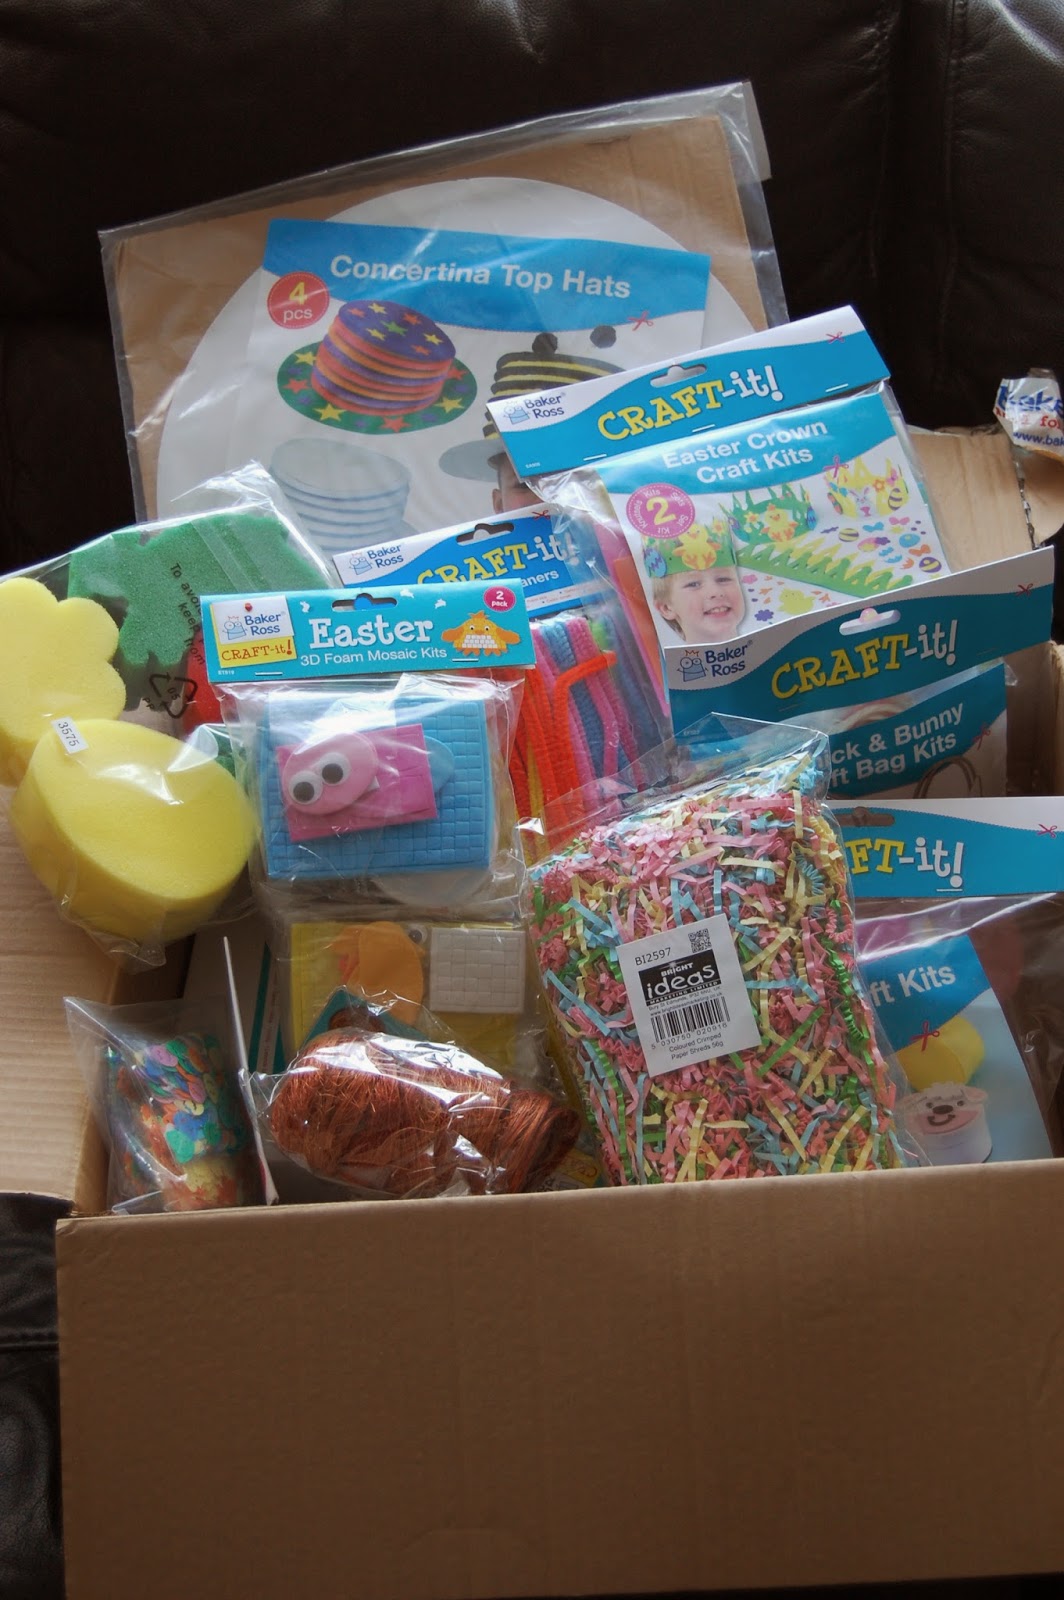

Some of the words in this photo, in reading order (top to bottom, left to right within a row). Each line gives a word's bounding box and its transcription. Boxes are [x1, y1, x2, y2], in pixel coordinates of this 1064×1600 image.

[330, 254, 490, 285] Concertina
[501, 264, 553, 294] Top
[563, 270, 631, 298] Hats
[289, 281, 307, 305] 4
[283, 306, 313, 323] pcs
[524, 395, 562, 409] Baker
[597, 365, 784, 441] CRAFT-it!
[532, 407, 565, 419] Ross
[663, 439, 741, 469] Easter
[748, 420, 828, 449] Crown
[696, 458, 761, 485] Craft
[767, 447, 813, 472] Kits
[646, 496, 677, 526] 2
[367, 544, 402, 560] Baker
[375, 553, 405, 568] Ross
[170, 563, 183, 579] To
[181, 582, 203, 615] avoi
[496, 591, 504, 600] 2
[491, 600, 508, 608] pack
[244, 612, 282, 626] Baker
[250, 624, 281, 636] Ross
[309, 614, 434, 649] Easter
[221, 639, 293, 661] CRAFT-it!
[301, 654, 321, 666] 3D
[324, 650, 364, 664] Foam
[368, 647, 418, 661] Mosaic
[420, 646, 447, 659] Kits
[705, 645, 748, 664] Baker
[771, 619, 959, 699] CRAFT-it!
[711, 660, 746, 677] Ross
[58, 722, 80, 747] 3575
[868, 733, 887, 753] &
[894, 702, 963, 746] Bunny
[856, 753, 906, 780] Bag
[913, 732, 957, 763] Kits
[634, 947, 672, 966] BI2597
[661, 962, 694, 978] BRIGHT
[898, 964, 957, 995] Kits
[647, 965, 716, 999] ideas
[649, 990, 688, 1005] MARKETING
[690, 981, 718, 993] LIMITED
[661, 1032, 691, 1046] 030750
[669, 1040, 696, 1052] Coloured
[697, 1032, 722, 1044] Crimped
[671, 1051, 688, 1060] Paper
[690, 1043, 711, 1055] Shreds
[712, 1040, 724, 1048] 56g
